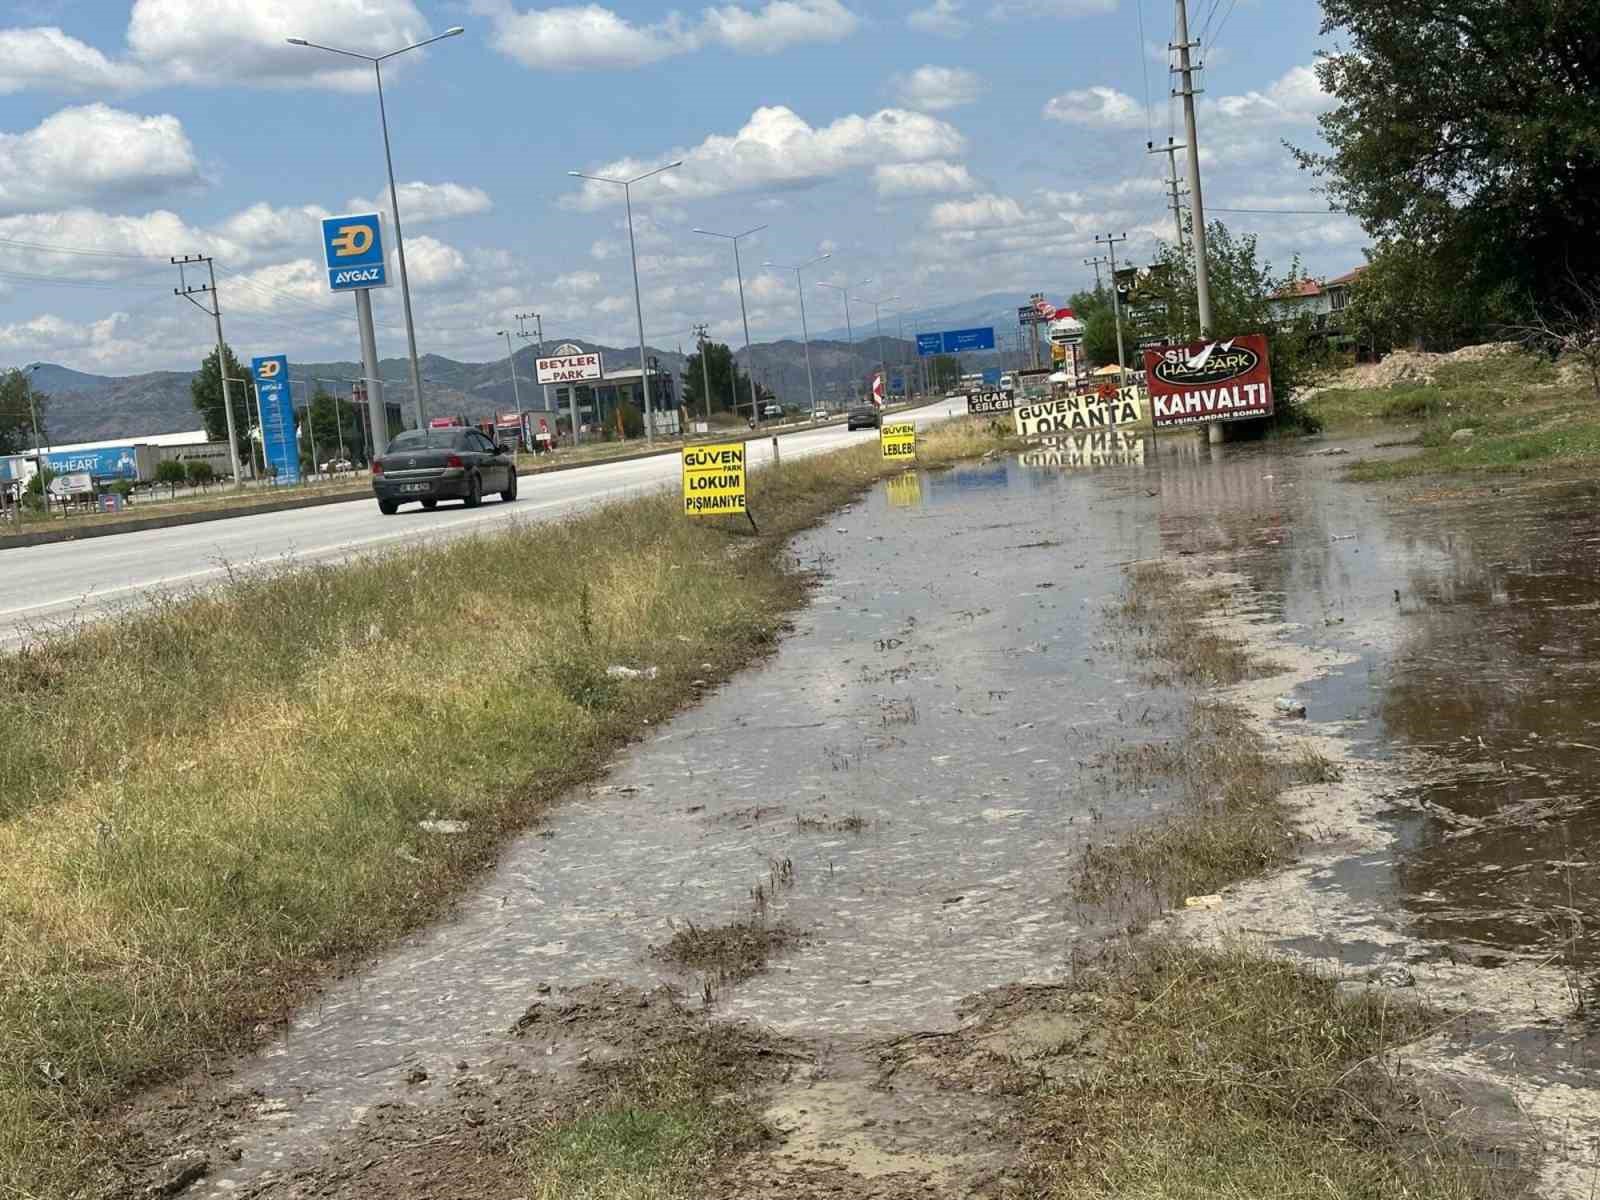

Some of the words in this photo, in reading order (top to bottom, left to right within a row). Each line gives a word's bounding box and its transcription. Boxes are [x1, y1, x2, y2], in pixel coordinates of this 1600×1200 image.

[336, 268, 379, 283] AYGAZ
[540, 357, 596, 370] BEYLER
[553, 370, 584, 380] PARK
[971, 391, 1008, 403] SICAK
[1153, 383, 1266, 417] KAHVALTI
[684, 448, 742, 466] GÜVEN
[690, 475, 740, 490] LOKUM
